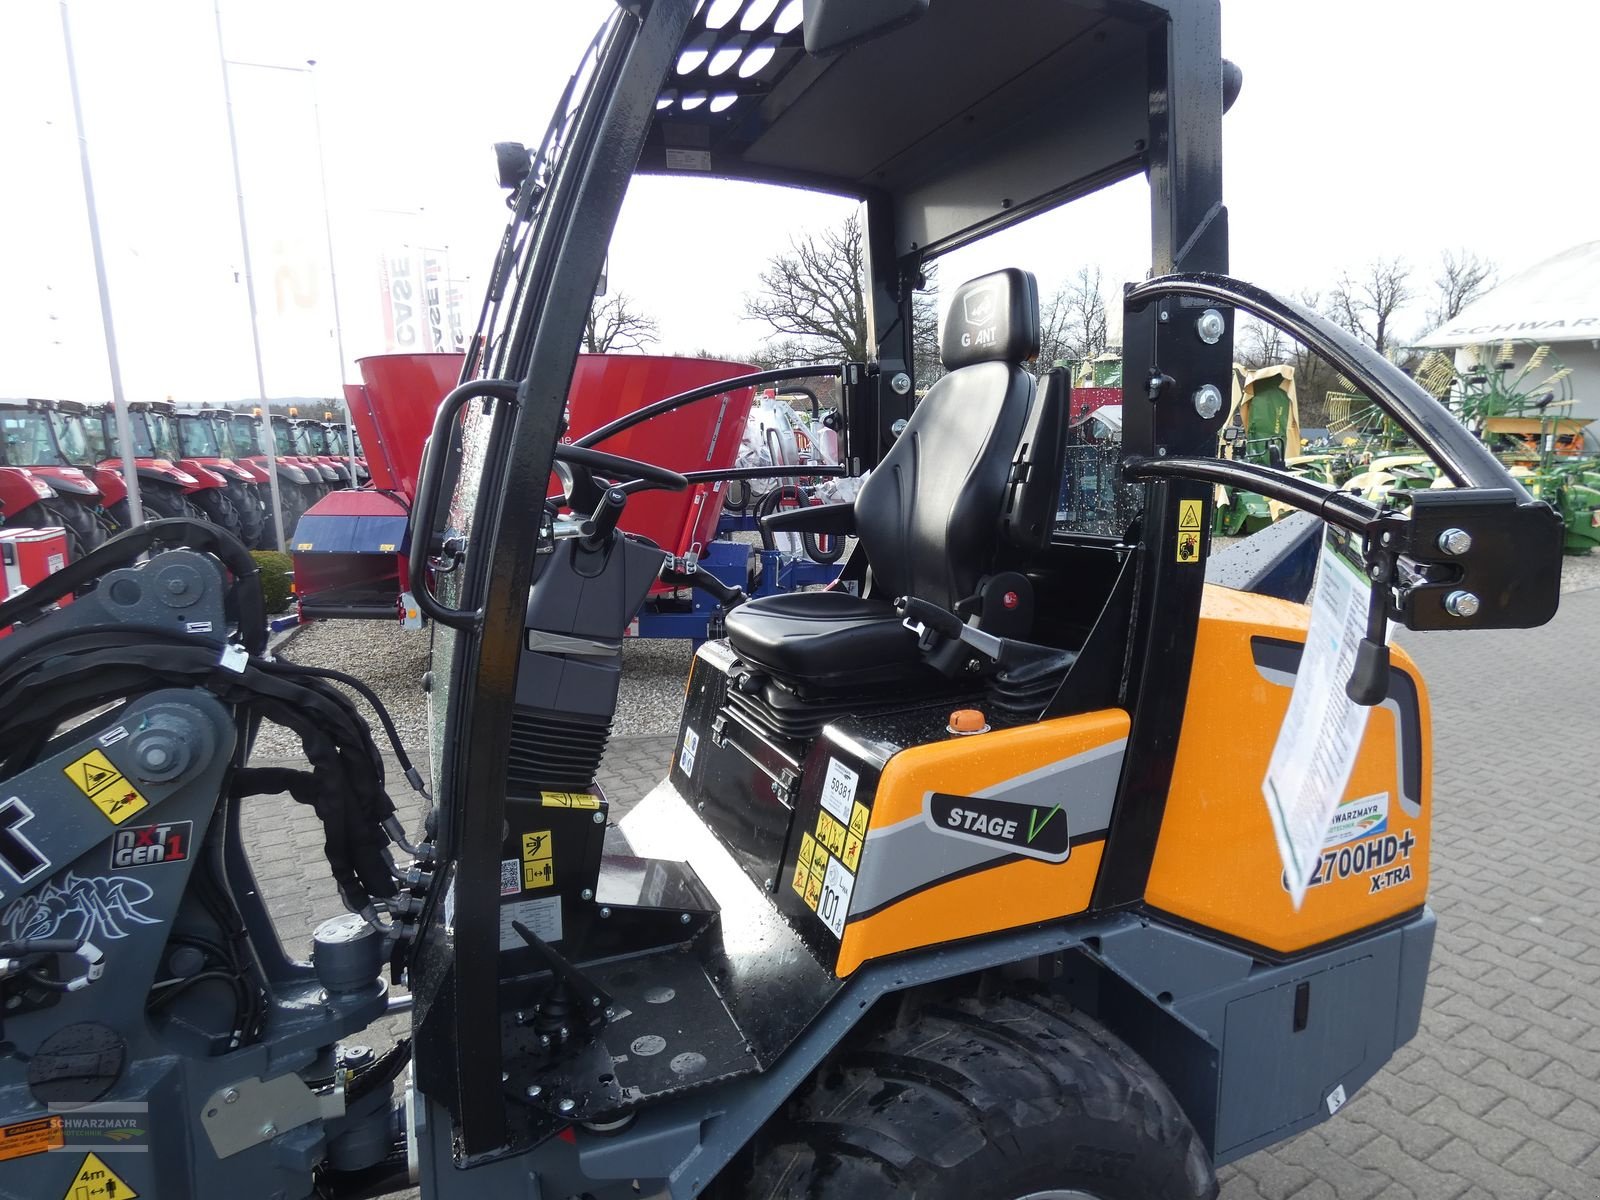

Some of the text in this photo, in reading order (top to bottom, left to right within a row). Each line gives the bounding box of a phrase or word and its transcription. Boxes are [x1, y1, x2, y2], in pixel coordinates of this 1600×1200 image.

[961, 326, 997, 347] GANT
[1448, 317, 1600, 337] SCHWAR
[830, 777, 852, 801] 59381
[947, 808, 1018, 839] STAGE
[1331, 804, 1378, 825] WARZMAYR
[1368, 863, 1412, 895] X-TRA
[821, 885, 839, 926] 101
[80, 1170, 105, 1181] 4m
